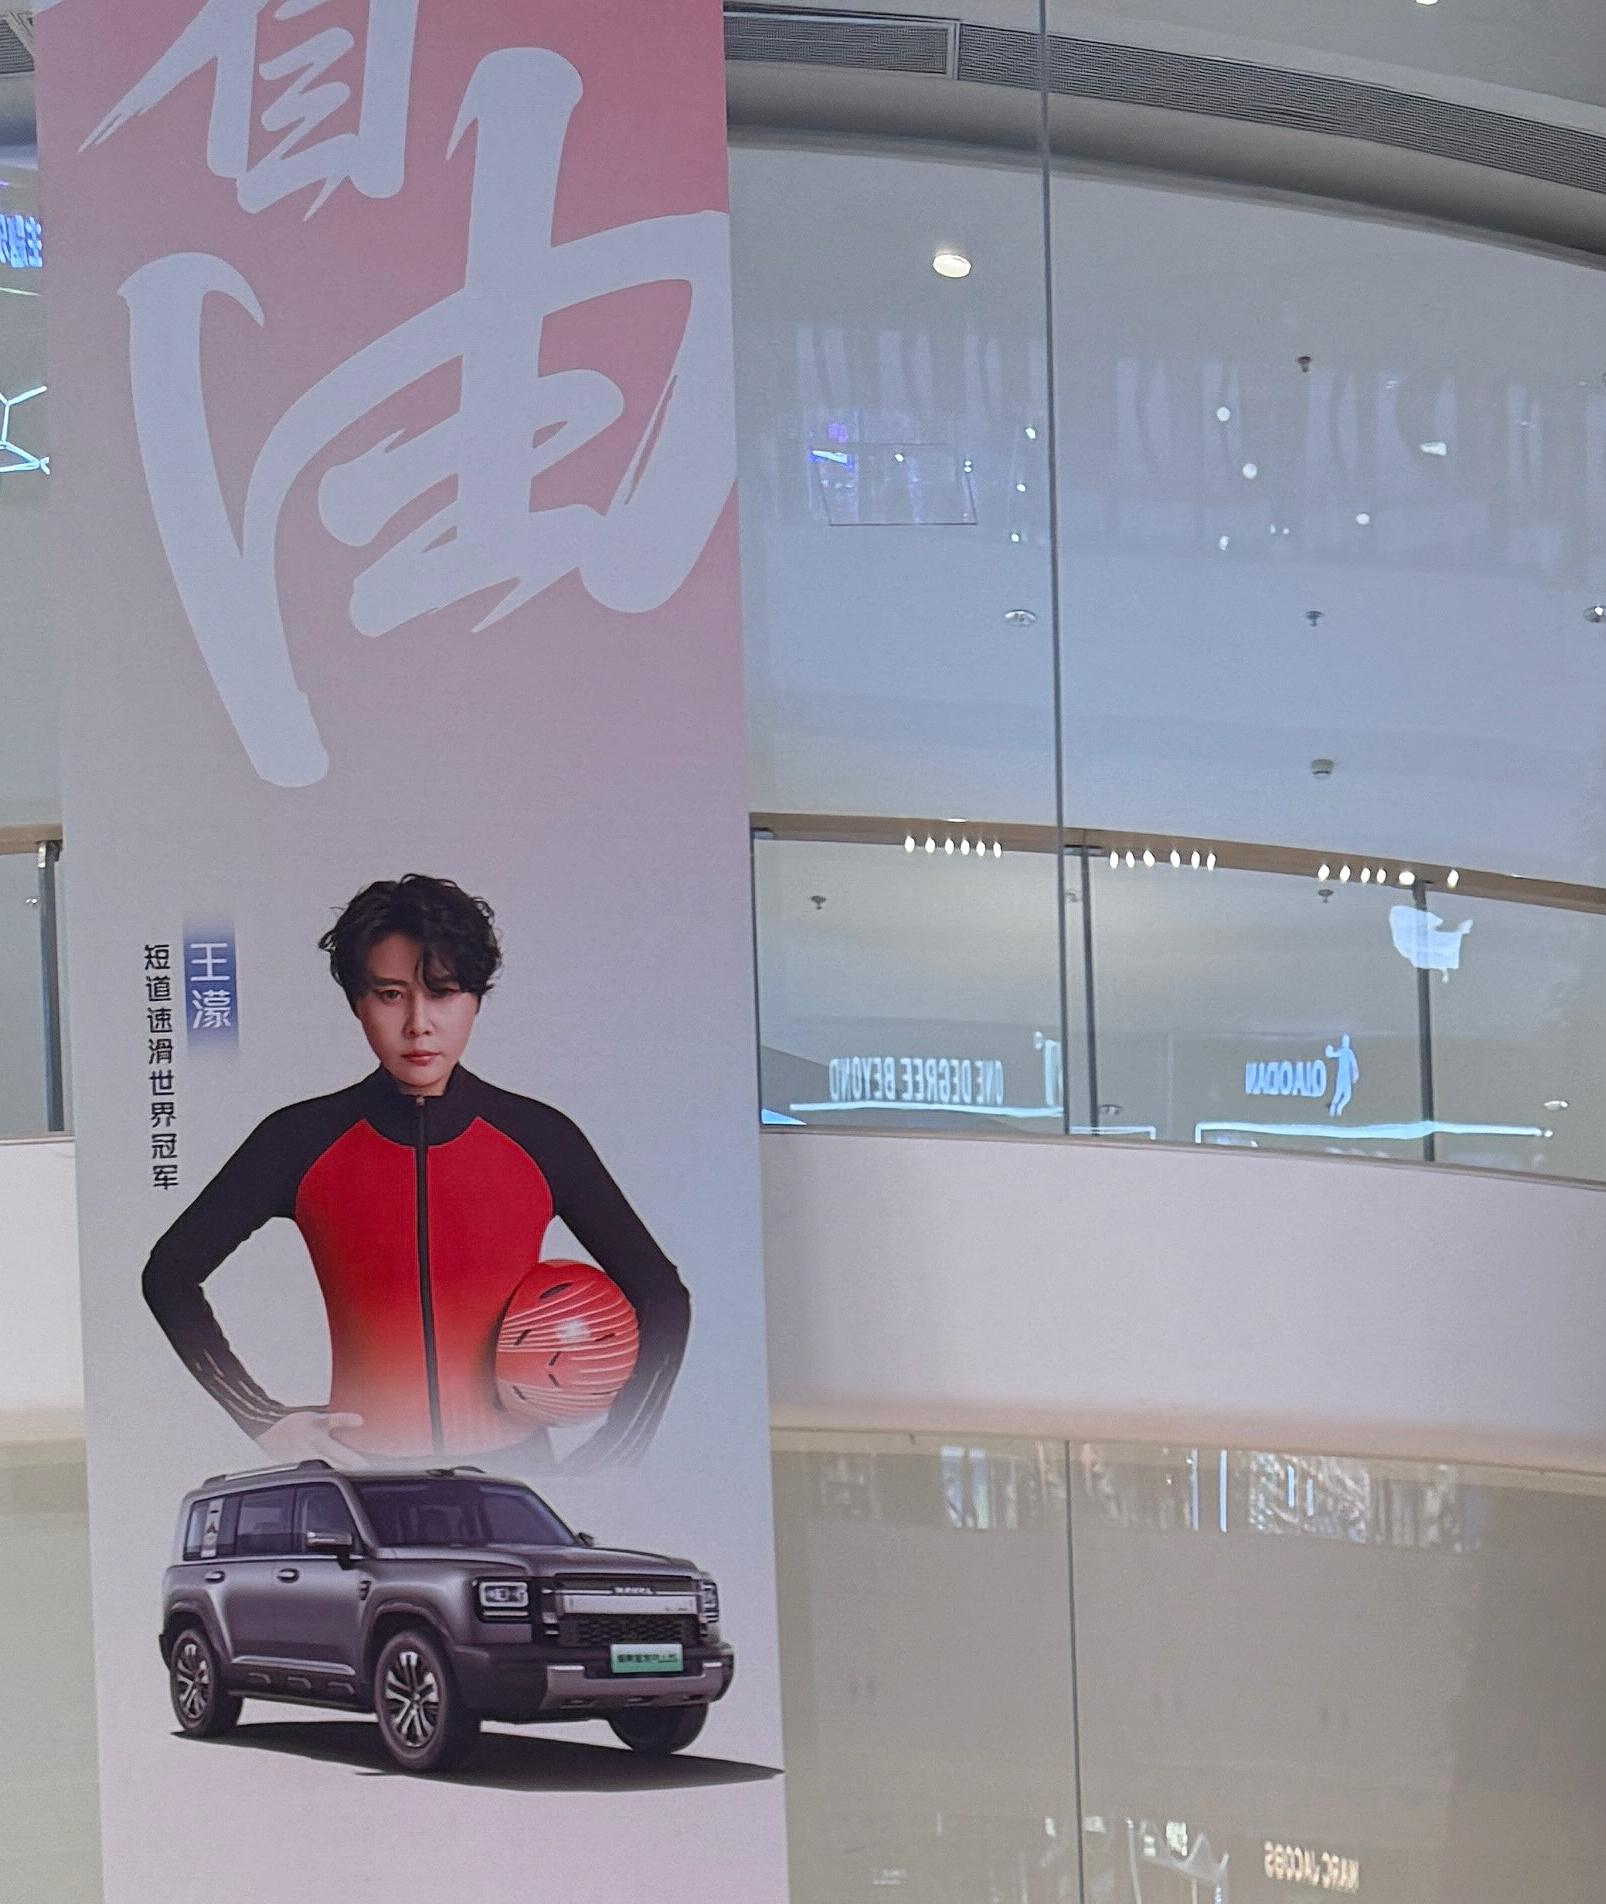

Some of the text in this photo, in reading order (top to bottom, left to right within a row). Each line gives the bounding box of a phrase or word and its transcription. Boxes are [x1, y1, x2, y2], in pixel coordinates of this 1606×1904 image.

[144, 944, 179, 1190] 短道速滑世界冠军
[190, 942, 232, 1029] 王濛
